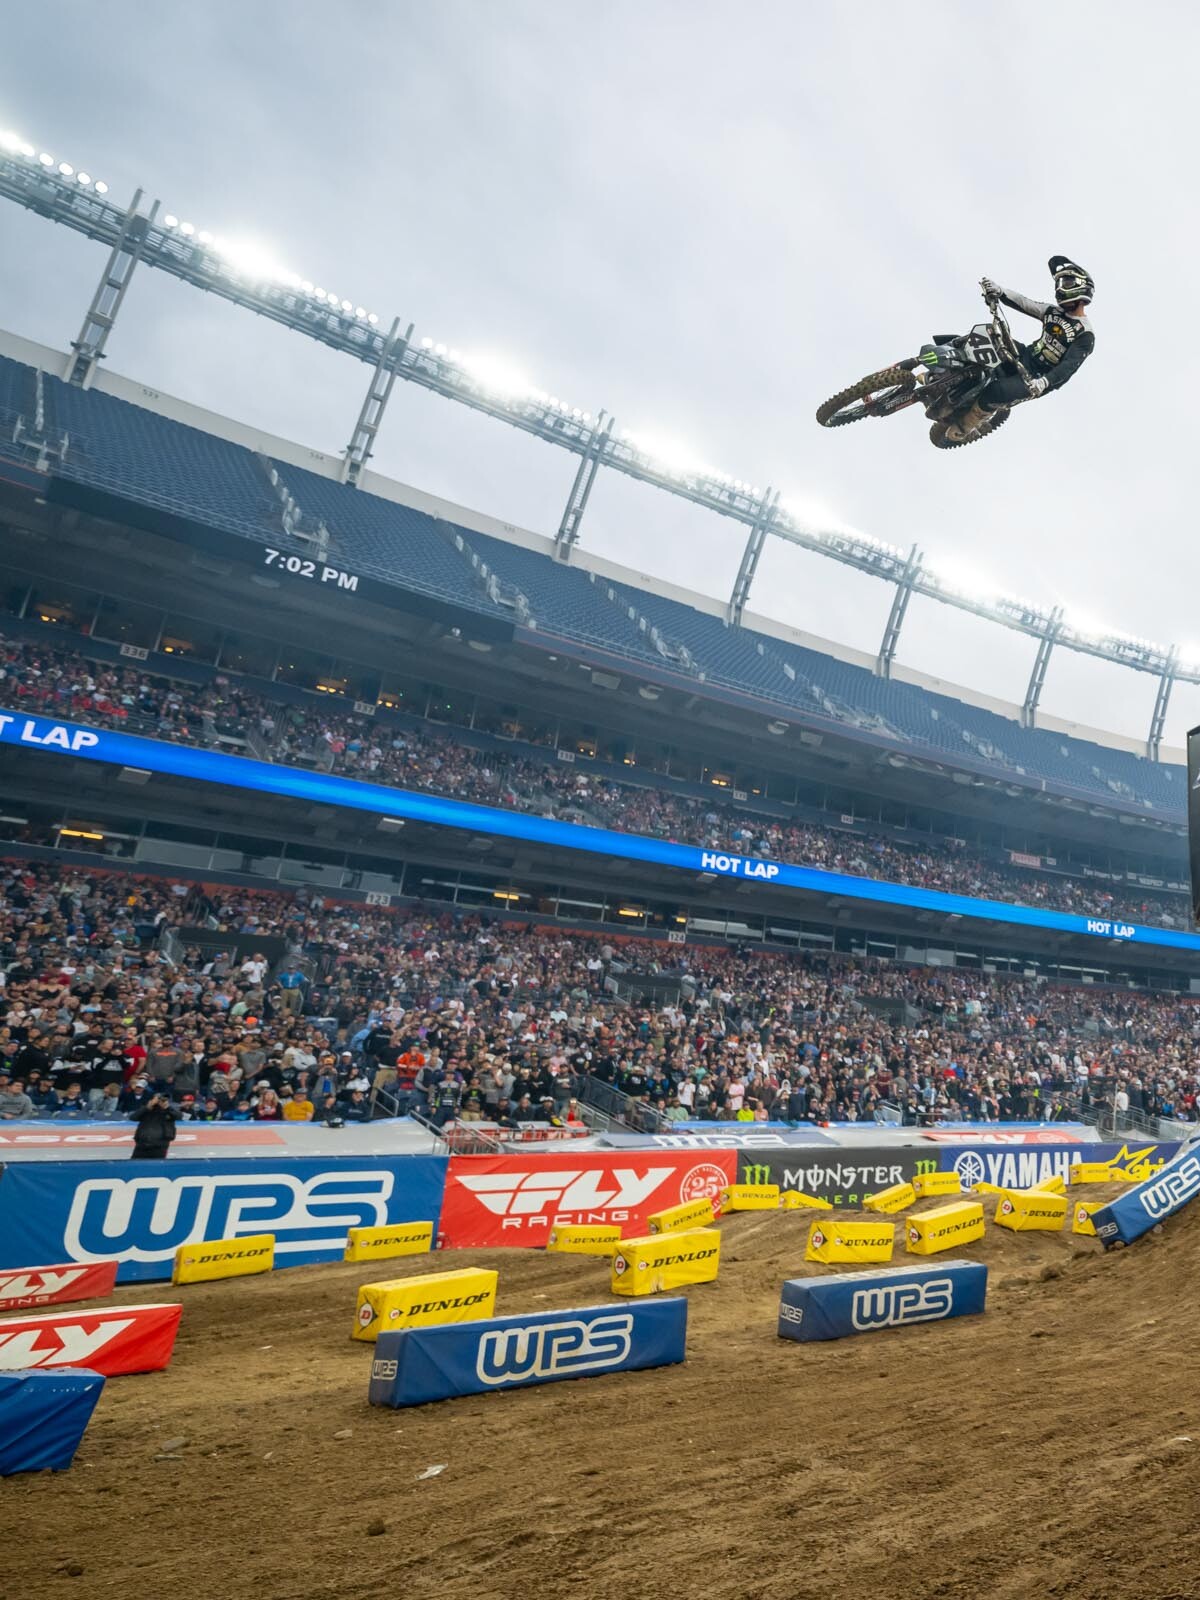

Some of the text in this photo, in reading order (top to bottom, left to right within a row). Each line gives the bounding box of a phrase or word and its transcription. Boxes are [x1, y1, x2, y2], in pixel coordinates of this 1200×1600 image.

[264, 549, 358, 591] 7:02 PM
[122, 645, 146, 659] 336
[20, 721, 100, 751] LAP
[702, 852, 779, 880] HOT LAP
[1088, 921, 1136, 938] HOT LAP
[691, 1176, 718, 1198] 25
[782, 1163, 906, 1192] MONSTER
[480, 1167, 677, 1215] FLY
[64, 1170, 395, 1263] WPS
[502, 1210, 630, 1230] RACING
[673, 1206, 712, 1227] DUNLOP
[1028, 1209, 1065, 1219] DUNLOP
[938, 1215, 984, 1238] DUNLOP
[372, 1232, 432, 1247] DUNLOP
[572, 1236, 619, 1244] DUNLOP
[844, 1237, 893, 1247] DUNLOP
[198, 1247, 270, 1264] DUNLOP
[651, 1248, 718, 1268] DUNLOP
[0, 1269, 89, 1299] LY
[407, 1291, 490, 1317] DUNLOP
[780, 1302, 803, 1324] WPS
[852, 1278, 954, 1331] WPS
[0, 1318, 136, 1369] LY
[476, 1314, 634, 1385] WPS
[371, 1359, 399, 1382] WPS
